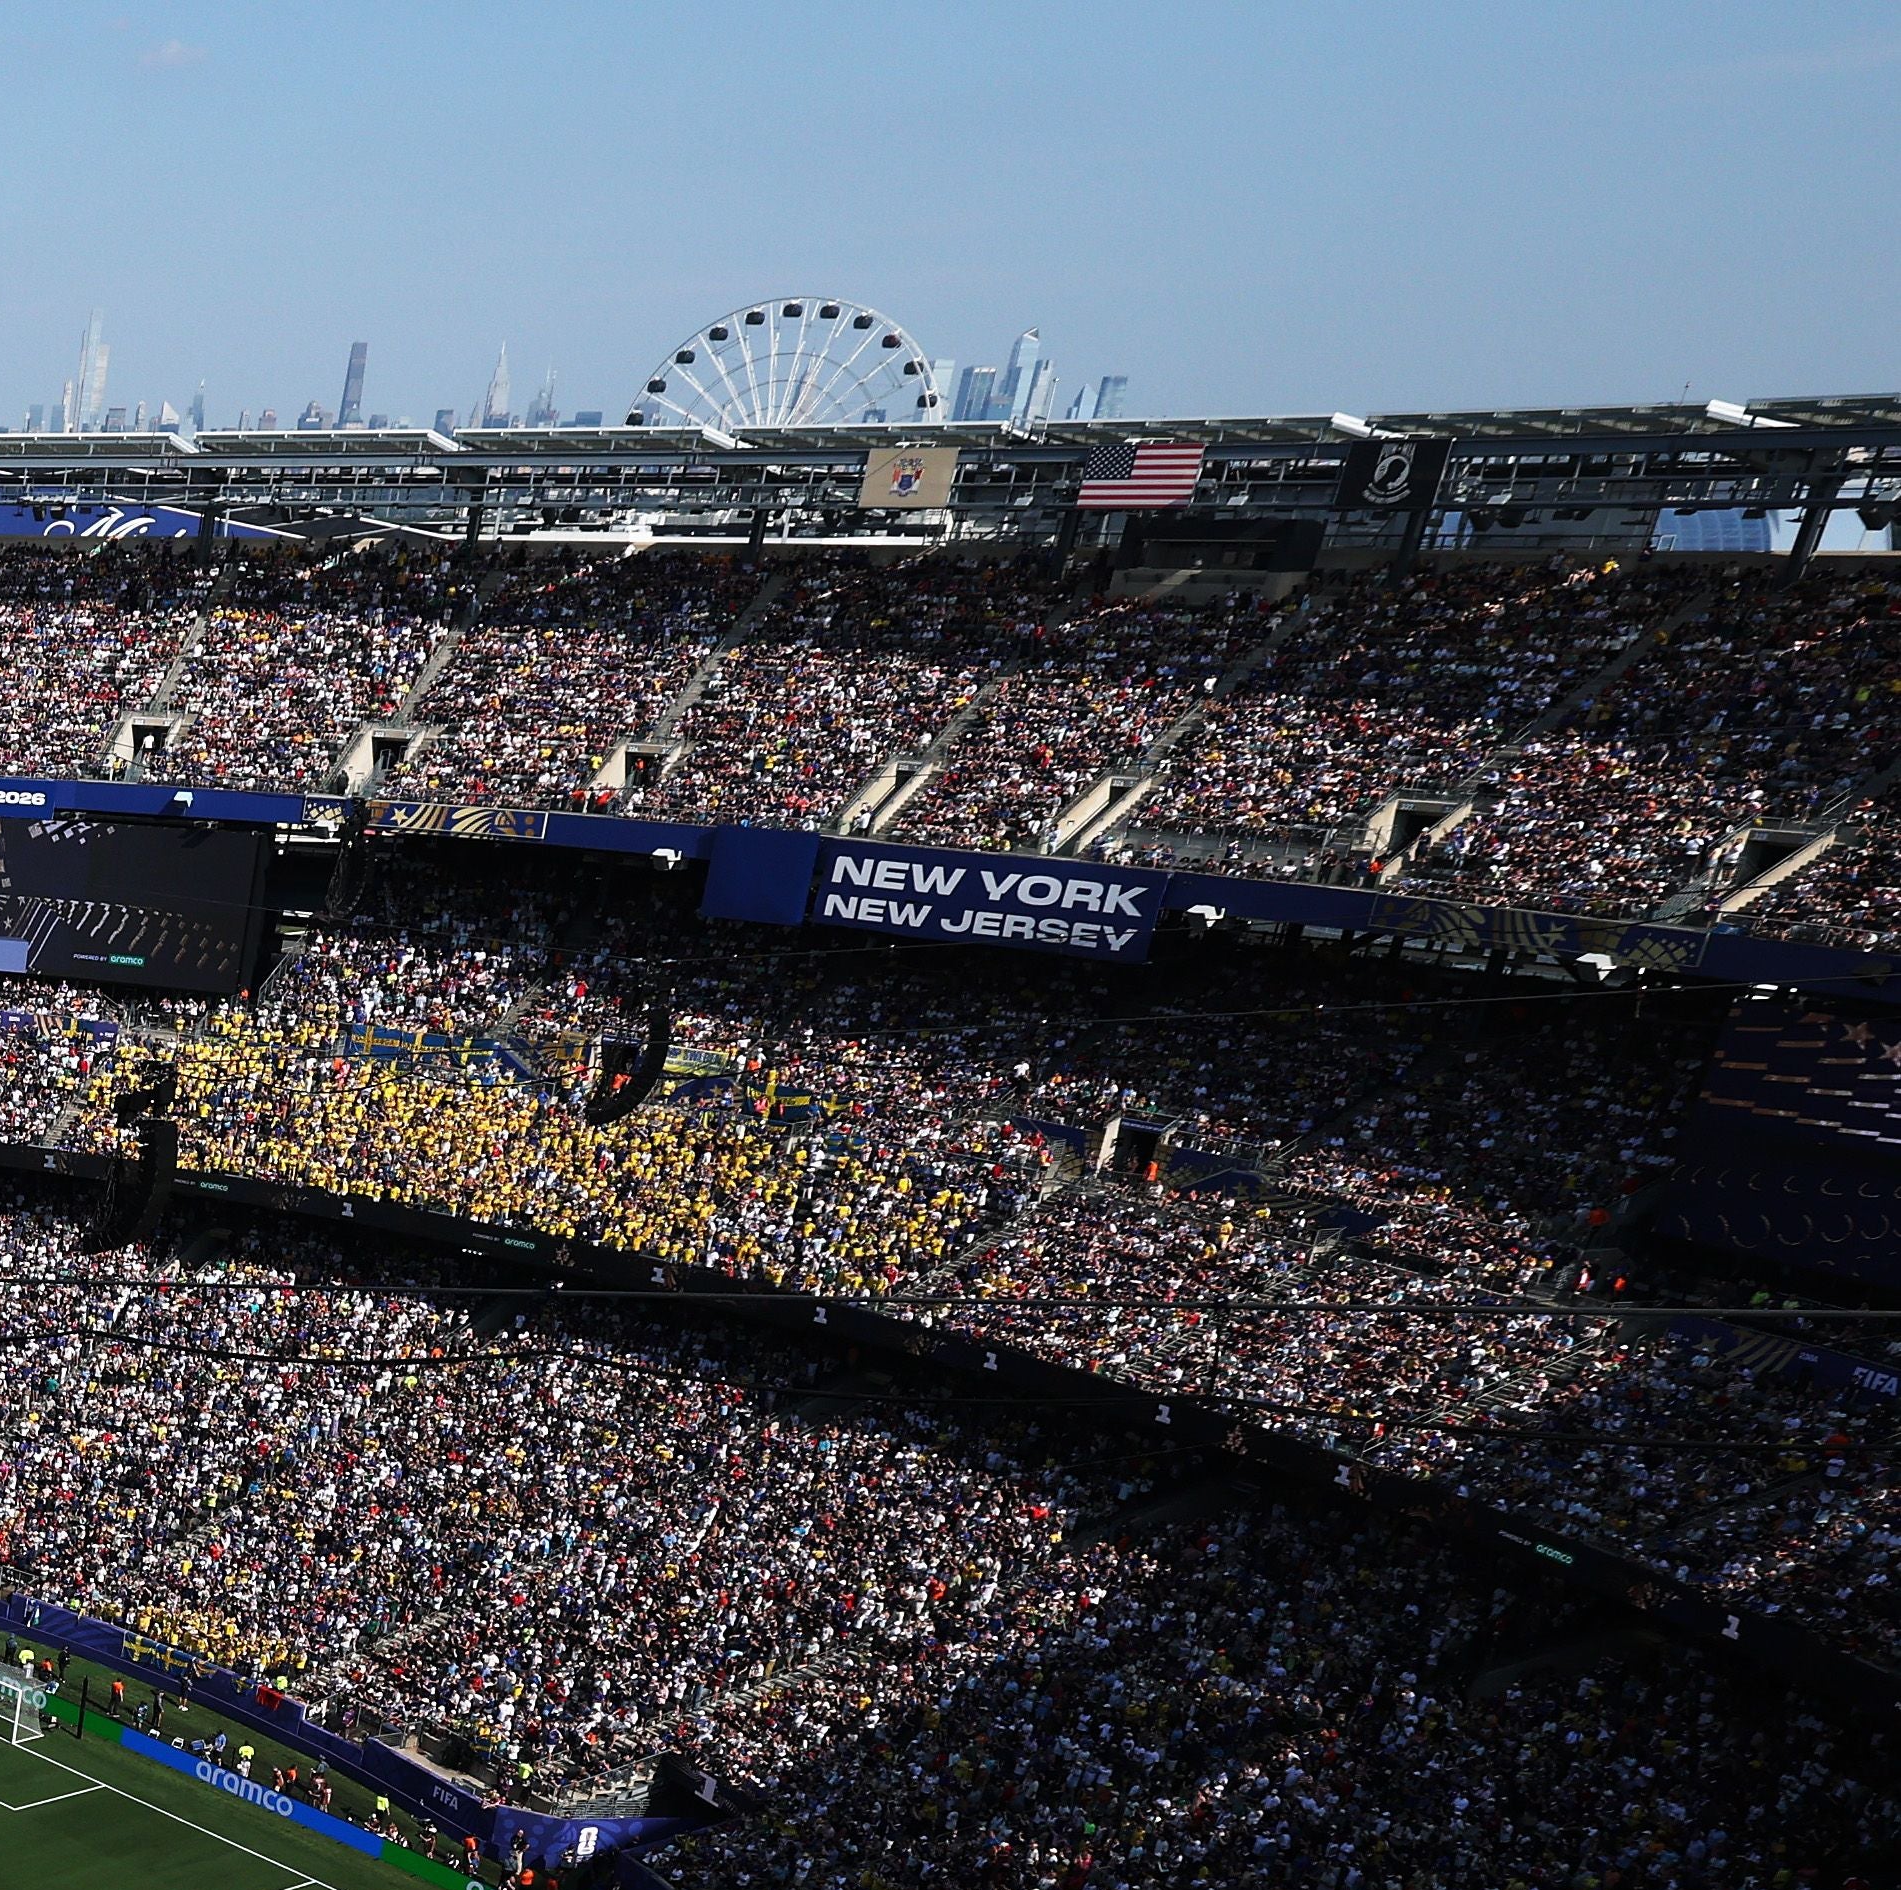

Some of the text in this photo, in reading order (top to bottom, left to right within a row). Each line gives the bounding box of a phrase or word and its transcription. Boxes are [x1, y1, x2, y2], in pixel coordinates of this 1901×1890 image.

[830, 853, 1149, 920] NEW YORK
[823, 892, 1140, 954] NEW JERSEY
[73, 953, 99, 961] POWERED
[110, 954, 144, 966] aramco
[43, 1154, 56, 1168] 1
[200, 1181, 229, 1191] aramco
[341, 1201, 353, 1217] 1
[504, 1238, 535, 1250] aramco
[650, 1266, 664, 1283] 1
[813, 1306, 827, 1324] 1
[983, 1351, 997, 1370] 1
[1852, 1365, 1899, 1395] FIFA
[1154, 1403, 1170, 1424] 1
[1333, 1464, 1351, 1485] 1
[1536, 1544, 1573, 1565] aramco
[1721, 1614, 1739, 1639] 1
[195, 1759, 295, 1817] aramco
[432, 1785, 459, 1810] FIFA
[694, 1770, 719, 1807] 1
